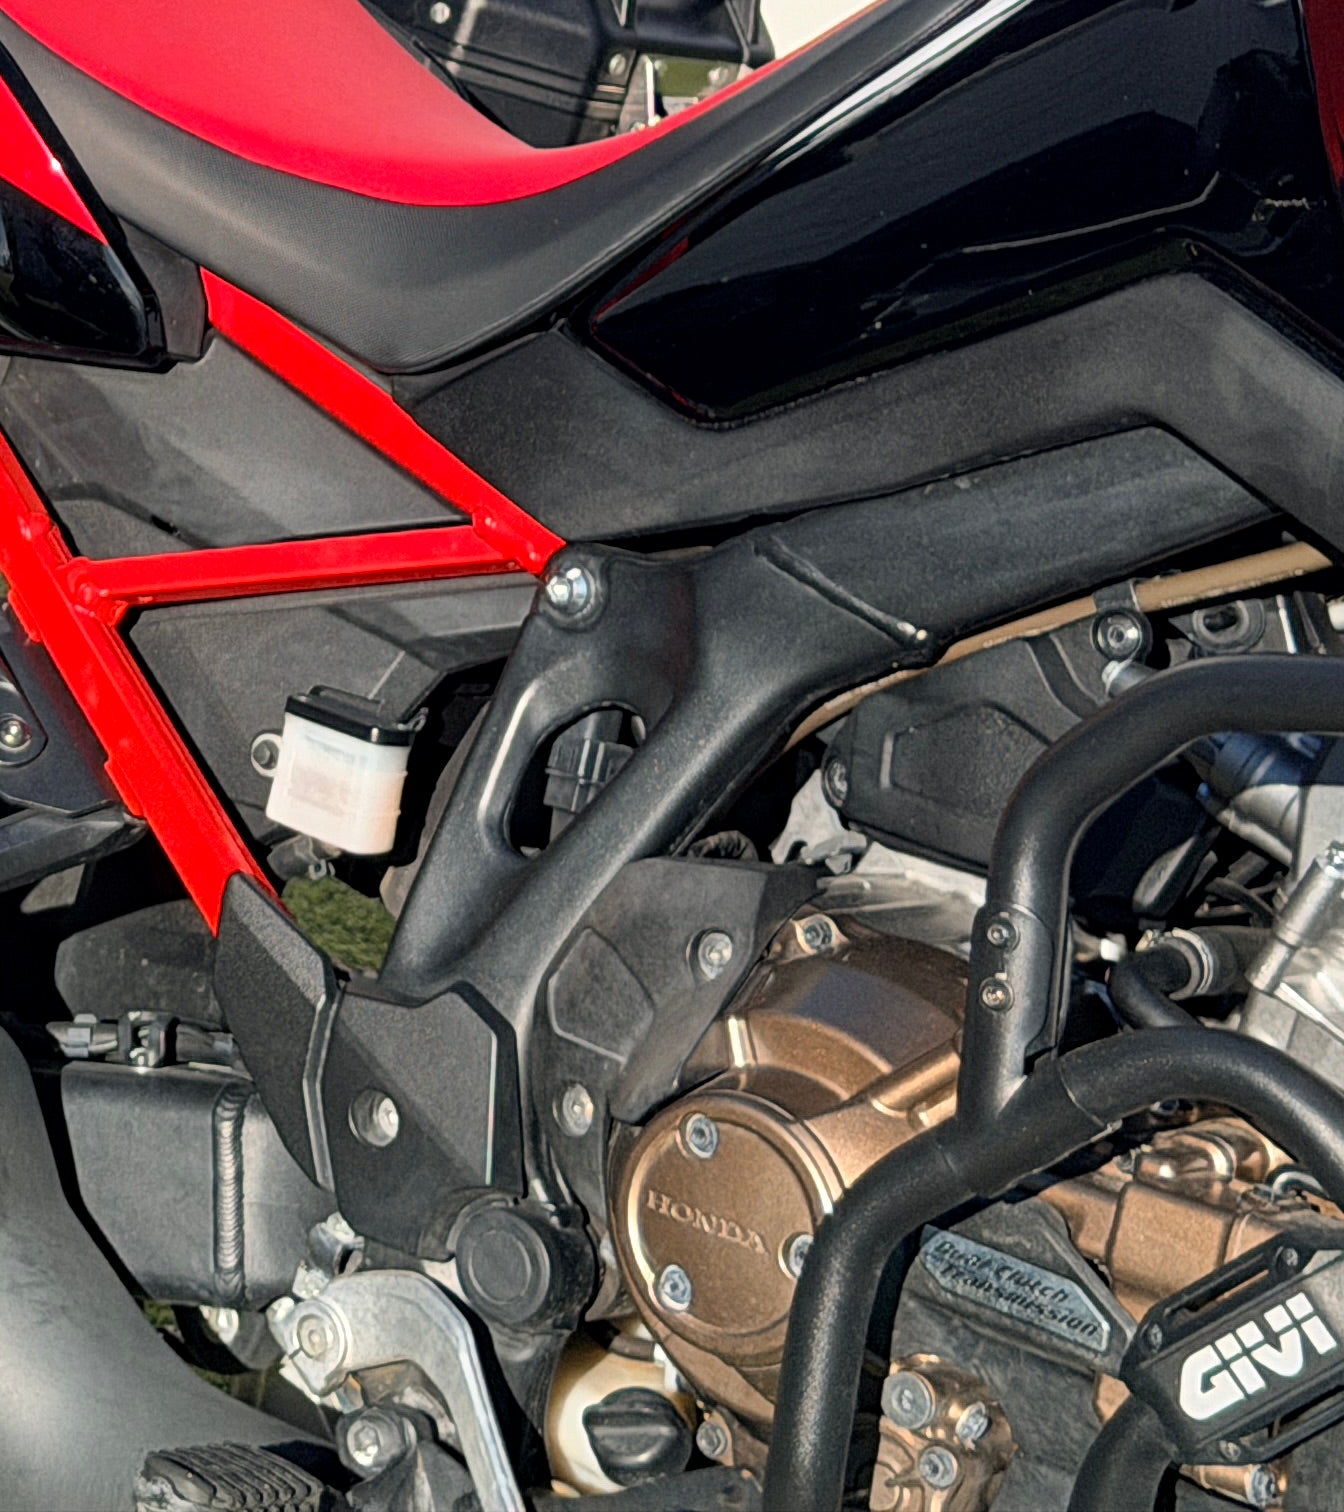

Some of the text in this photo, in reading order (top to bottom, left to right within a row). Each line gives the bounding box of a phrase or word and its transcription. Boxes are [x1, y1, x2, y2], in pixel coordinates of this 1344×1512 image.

[646, 1189, 770, 1256] HONDA
[934, 1240, 1069, 1303] Dual Clutch
[940, 1264, 1098, 1337] Transmission
[1179, 1292, 1338, 1420] GIVI
